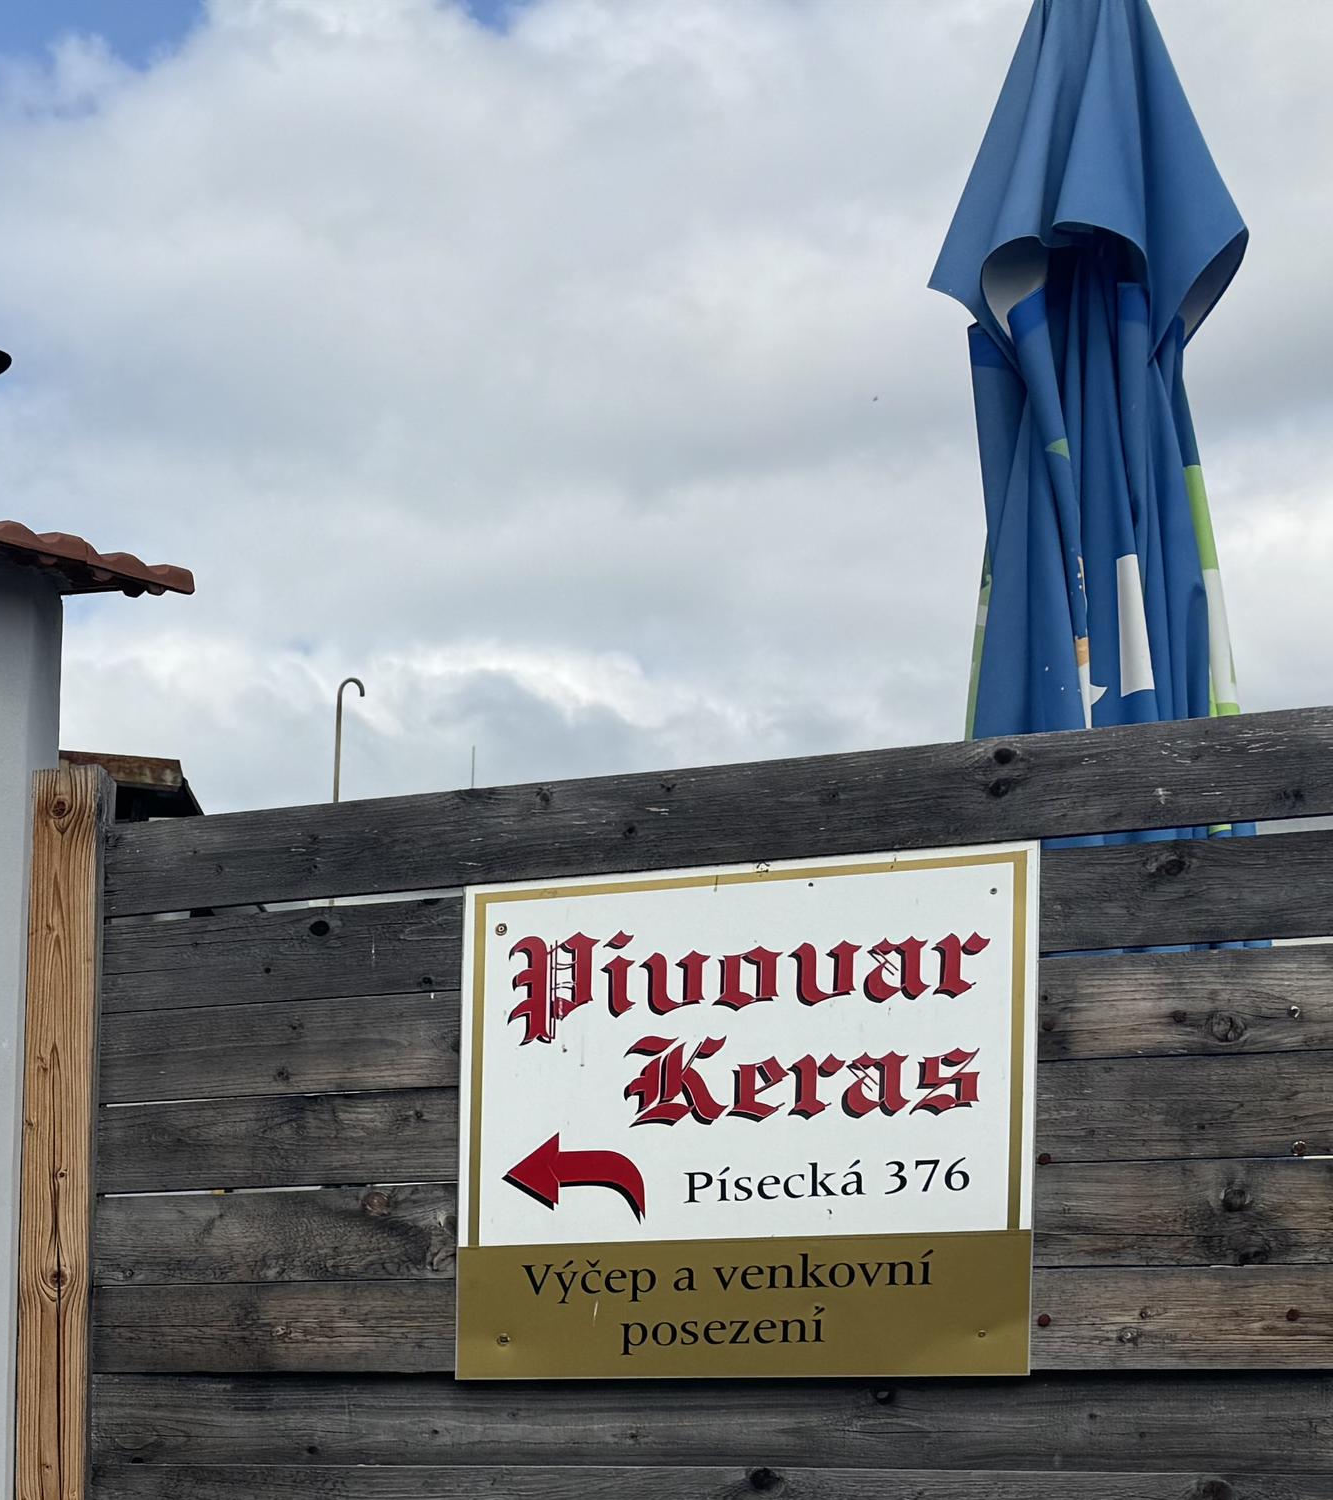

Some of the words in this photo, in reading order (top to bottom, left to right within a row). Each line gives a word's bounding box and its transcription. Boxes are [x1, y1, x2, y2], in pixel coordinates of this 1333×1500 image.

[507, 930, 991, 1046] Pivovar
[622, 1035, 982, 1128] Keras
[683, 1160, 866, 1204] Písecká
[884, 1156, 971, 1195] 376
[522, 1259, 657, 1304] Výčep
[672, 1267, 697, 1292] a
[713, 1248, 935, 1292] venkovní
[620, 1307, 826, 1356] posezení
